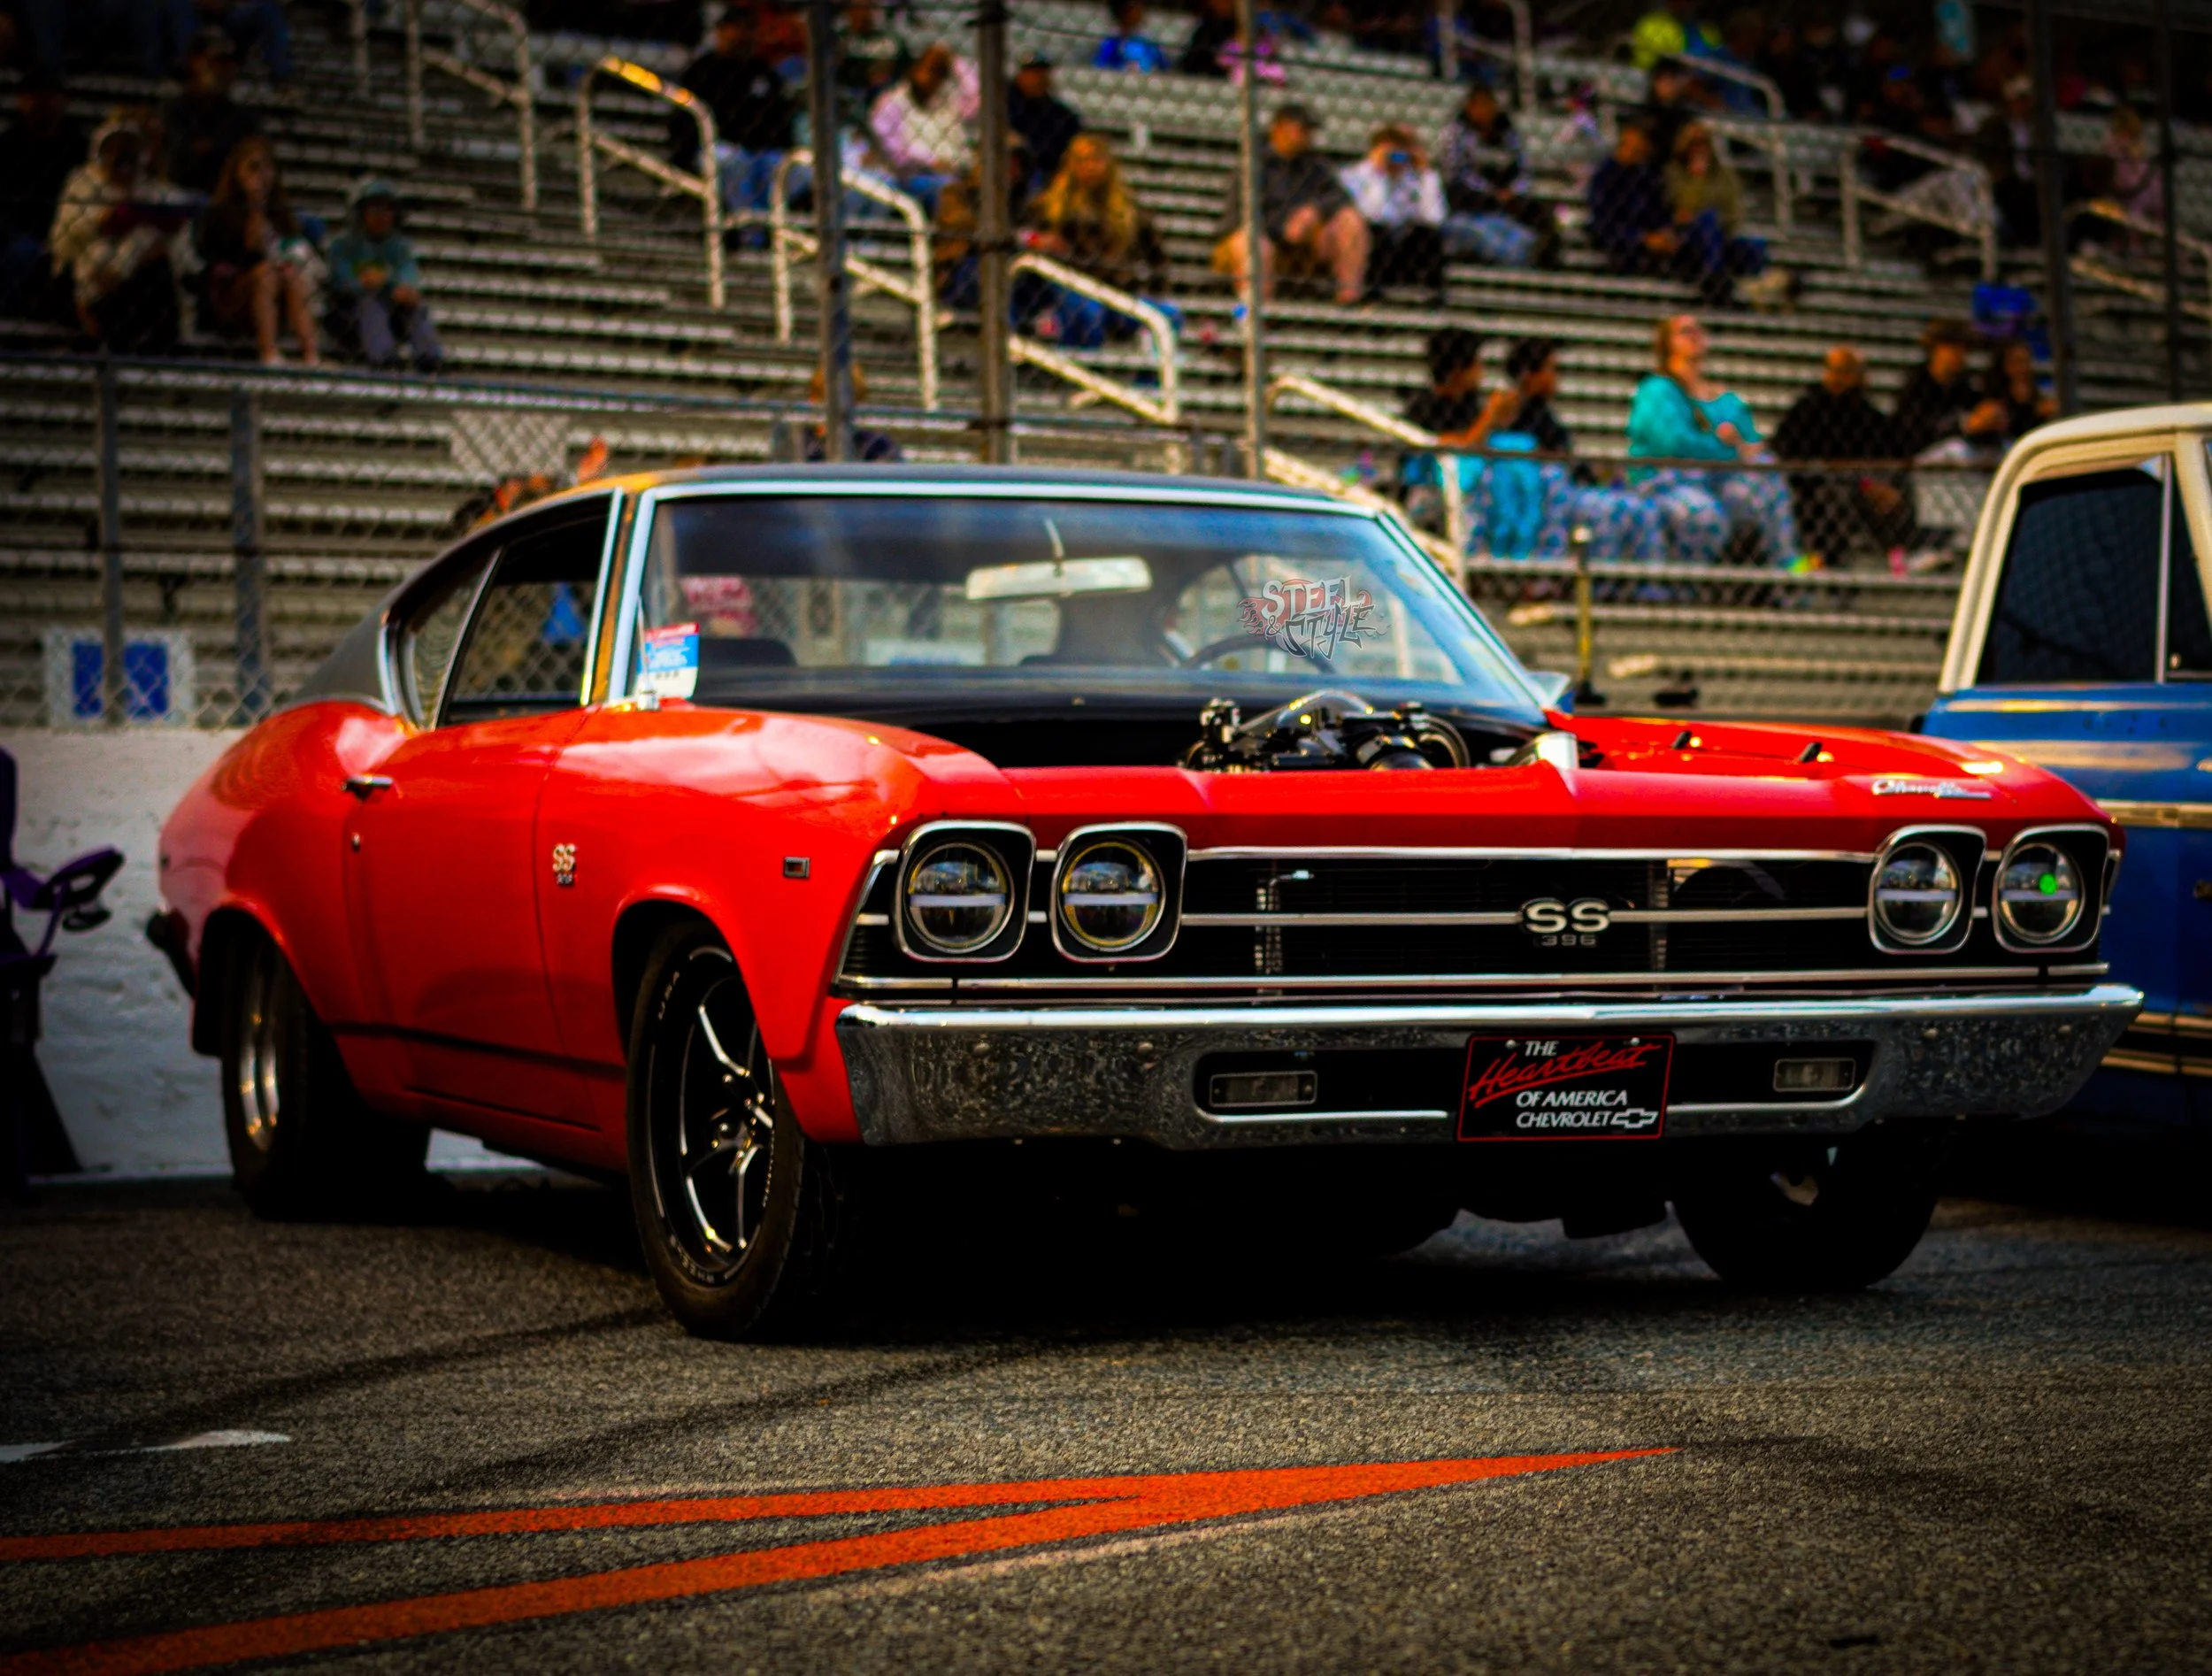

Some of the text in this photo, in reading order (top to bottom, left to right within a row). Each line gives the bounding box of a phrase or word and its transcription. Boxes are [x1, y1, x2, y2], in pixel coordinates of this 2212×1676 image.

[553, 843, 576, 873] SS
[1525, 900, 1610, 934] SS
[1540, 934, 1597, 947] 396
[1525, 1040, 1559, 1057] THE
[1469, 1041, 1662, 1102] Heartbeat
[1516, 1090, 1628, 1107] OF AMERICA
[1516, 1111, 1613, 1128] CHEVROLET
